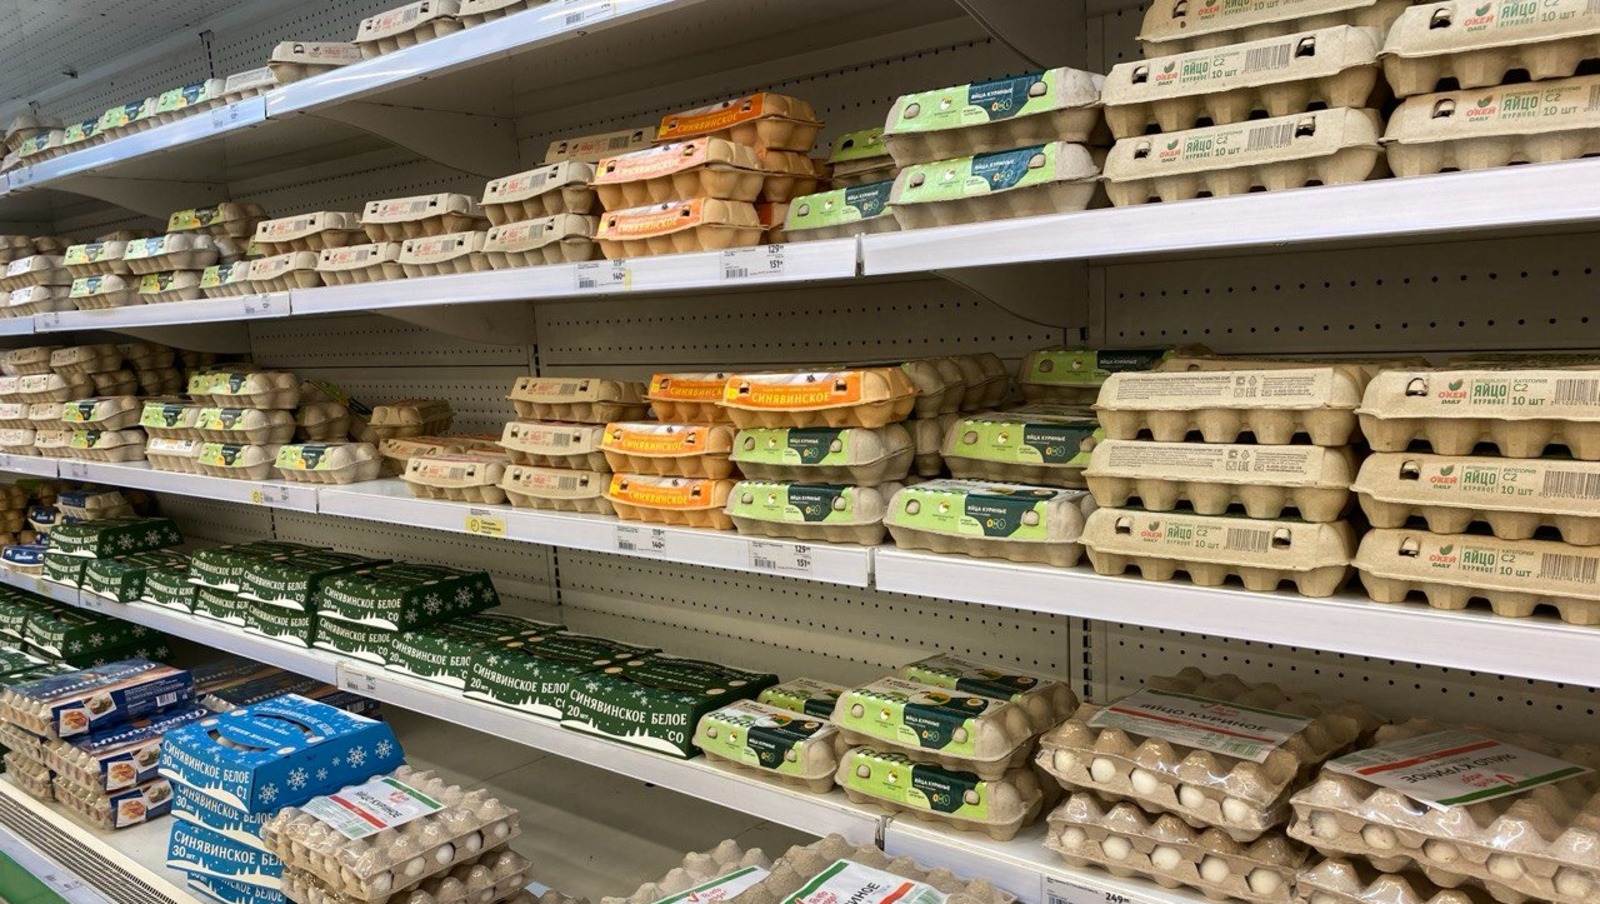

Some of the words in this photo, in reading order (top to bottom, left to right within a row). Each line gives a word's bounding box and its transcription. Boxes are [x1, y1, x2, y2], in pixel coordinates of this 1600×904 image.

[1225, 0, 1250, 9] ЯЙЦО
[1254, 1, 1264, 11] 10
[1502, 2, 1536, 18] ЯЙЦО
[1542, 11, 1556, 22] 10
[1183, 60, 1209, 76] ЯЙЦО
[1213, 59, 1225, 67] С2
[1212, 69, 1222, 79] 10
[1503, 95, 1538, 111] ЯЙЦО
[1544, 94, 1561, 102] С2
[1543, 106, 1558, 117] 10
[678, 115, 738, 133] СИНЯВИНСКОЕ
[1186, 138, 1212, 152] ЯЙЦО
[1216, 137, 1228, 145] С2
[1215, 148, 1226, 157] 10
[670, 386, 724, 398] СИНЯВИНСК
[1474, 383, 1507, 397] ЯЙЦО
[1513, 384, 1529, 392] С2
[751, 391, 831, 405] СИНЯВИНСКОЕ
[1512, 396, 1525, 406] 10
[622, 440, 683, 451] СИНЯВИНСКОЕ
[1464, 470, 1496, 485] ЯЙЦО
[1502, 473, 1517, 482] С2
[1501, 485, 1514, 495] 10
[629, 492, 688, 505] СИНЯВИНСКОЕ
[1167, 524, 1192, 540] ЯЙЦО
[1196, 529, 1207, 537] С2
[1195, 539, 1205, 549] 10
[1463, 549, 1495, 566] ЯЙЦО
[1501, 554, 1516, 563] С2
[231, 567, 244, 576] БЕЛ
[1499, 566, 1513, 576] 10
[242, 582, 250, 590] 20
[244, 571, 285, 591] СИНЯВИНСКОЕ
[287, 581, 307, 591] БЕЛОЕ
[322, 599, 331, 608] 20
[325, 587, 375, 609] СИНЯВИНСКОЕ
[377, 598, 402, 609] БЕЛОЕ
[237, 600, 249, 609] БЕЛ
[247, 616, 255, 625] 20
[249, 605, 289, 626] СИНЯВИНСКОЕ
[290, 617, 309, 627] БЕЛОЕ
[317, 630, 326, 640] 20
[320, 618, 366, 643] СИНЯВИНСКОЕ
[368, 633, 390, 643] БЕЛОЕ
[390, 652, 400, 662] 20
[392, 639, 447, 665] СИНЯВИНСКОЕ
[450, 655, 472, 667] БЕЛО
[470, 677, 481, 688] 20
[473, 663, 538, 692] СИНЯВИНСКОЕ
[541, 682, 569, 693] БЕЛО
[567, 705, 580, 717] 20
[570, 689, 646, 723] СИНЯВИНСКОЕ
[651, 712, 687, 726] БЕЛОЕ
[1139, 703, 1187, 716] ЯЙЦО
[1187, 711, 1270, 733] КУРИНОЕ
[162, 754, 172, 766] 30
[164, 740, 220, 781] СИНЯВИНСКОЕ
[223, 768, 250, 784] БЕЛОЕ
[1474, 754, 1517, 771] ЯЙЦО
[1399, 762, 1473, 785] КУРИНОЕ
[236, 786, 248, 799] С1
[175, 796, 187, 808] 30
[178, 784, 239, 820] СИНЯВИНСКОЕ
[172, 845, 186, 857] 30
[174, 831, 256, 865] СИНЯВИНСКОЕ
[262, 853, 284, 866] БЕЛ
[845, 882, 881, 904] ИНОЕ
